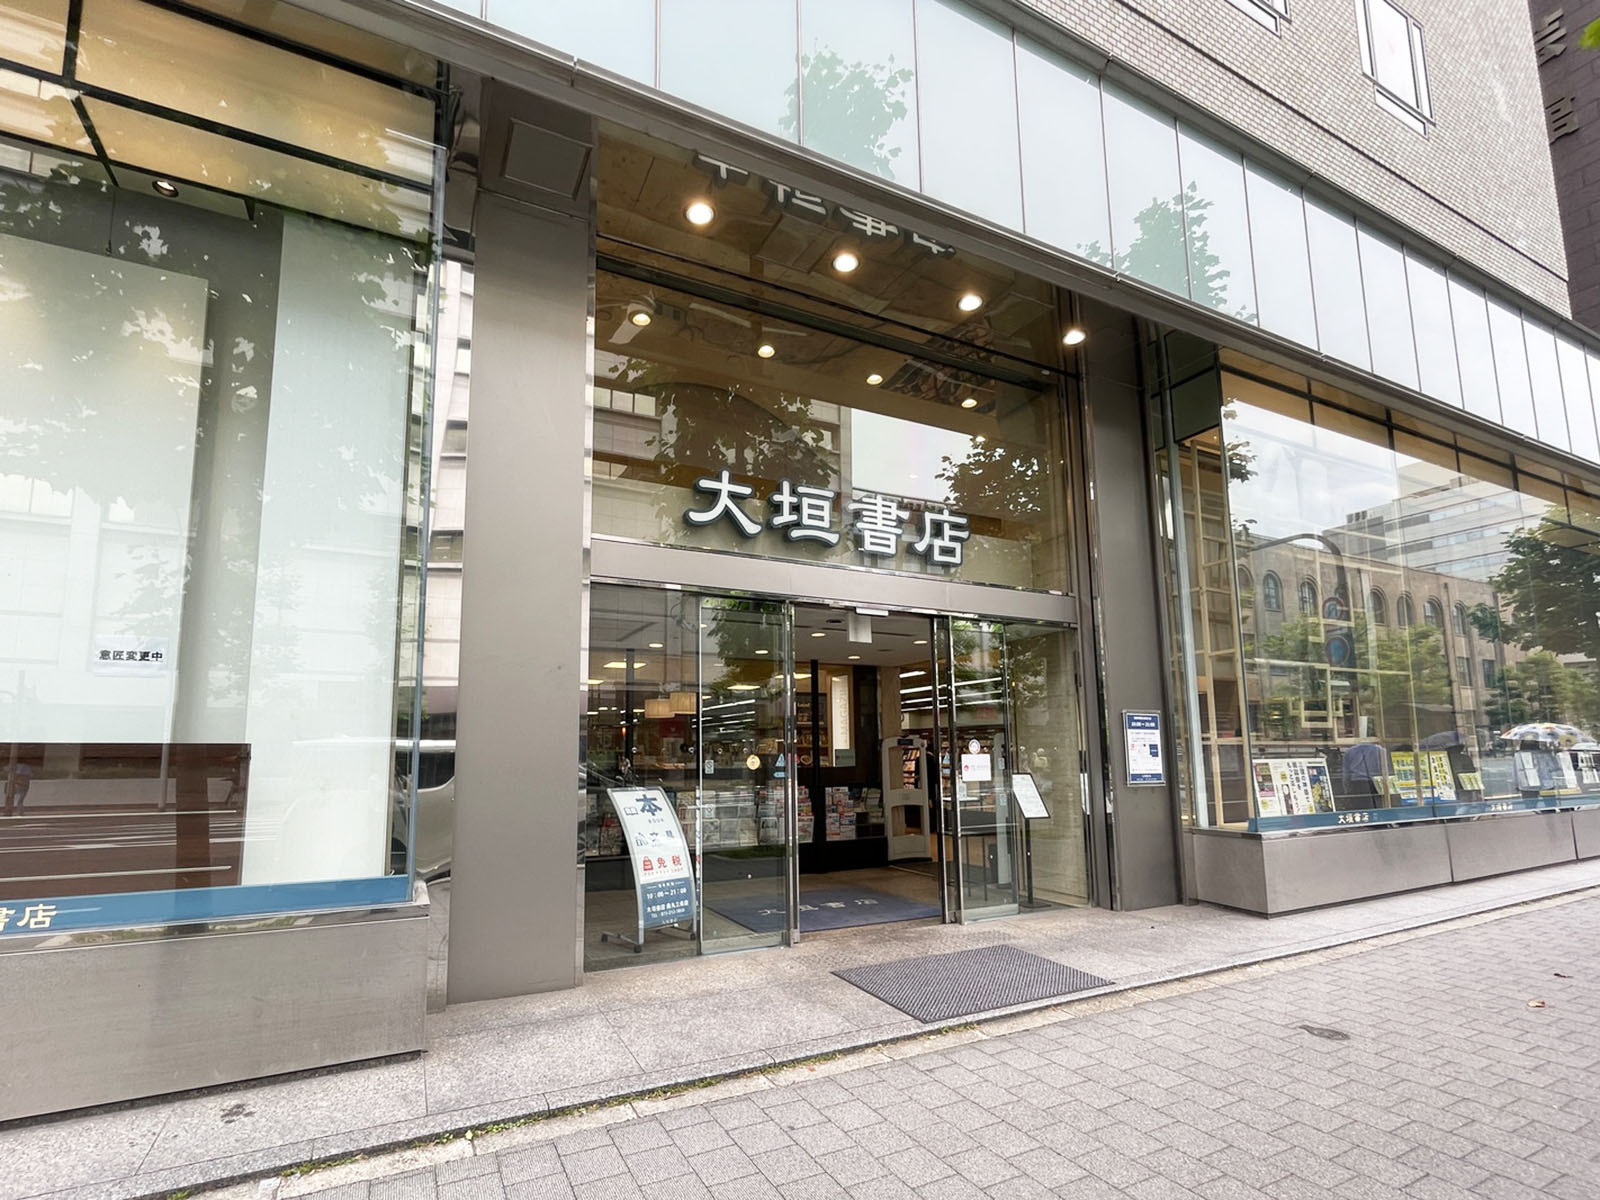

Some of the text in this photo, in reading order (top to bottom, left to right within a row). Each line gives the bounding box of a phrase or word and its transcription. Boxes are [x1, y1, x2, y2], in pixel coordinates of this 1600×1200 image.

[685, 469, 970, 565] 大垣書店
[99, 650, 163, 661] 意匠変更中
[635, 794, 663, 816] 本
[657, 854, 682, 869] 免税
